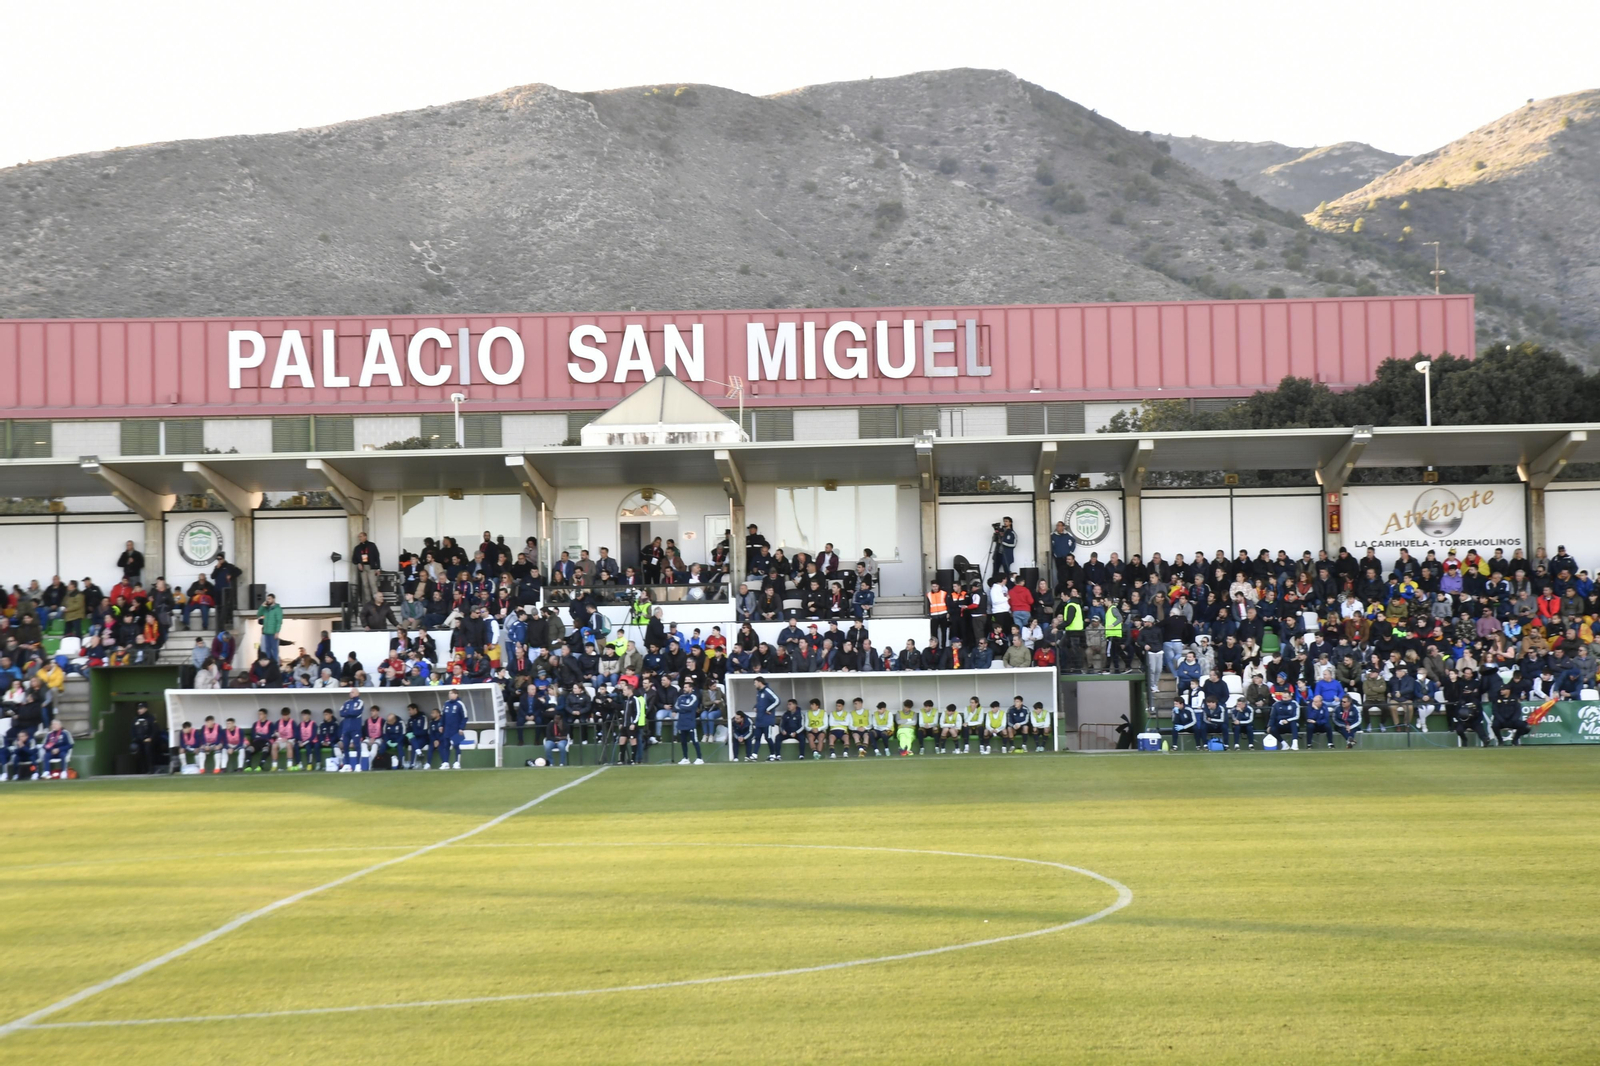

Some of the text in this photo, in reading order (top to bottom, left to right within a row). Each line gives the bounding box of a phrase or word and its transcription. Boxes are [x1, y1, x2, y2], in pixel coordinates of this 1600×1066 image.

[228, 319, 992, 389] PALACIO SAN MIGUEL
[1380, 489, 1495, 536] Atrévete
[1354, 540, 1368, 548] LA
[1371, 539, 1430, 548] CARIHUELA
[1438, 538, 1521, 547] TORREMOLINOS
